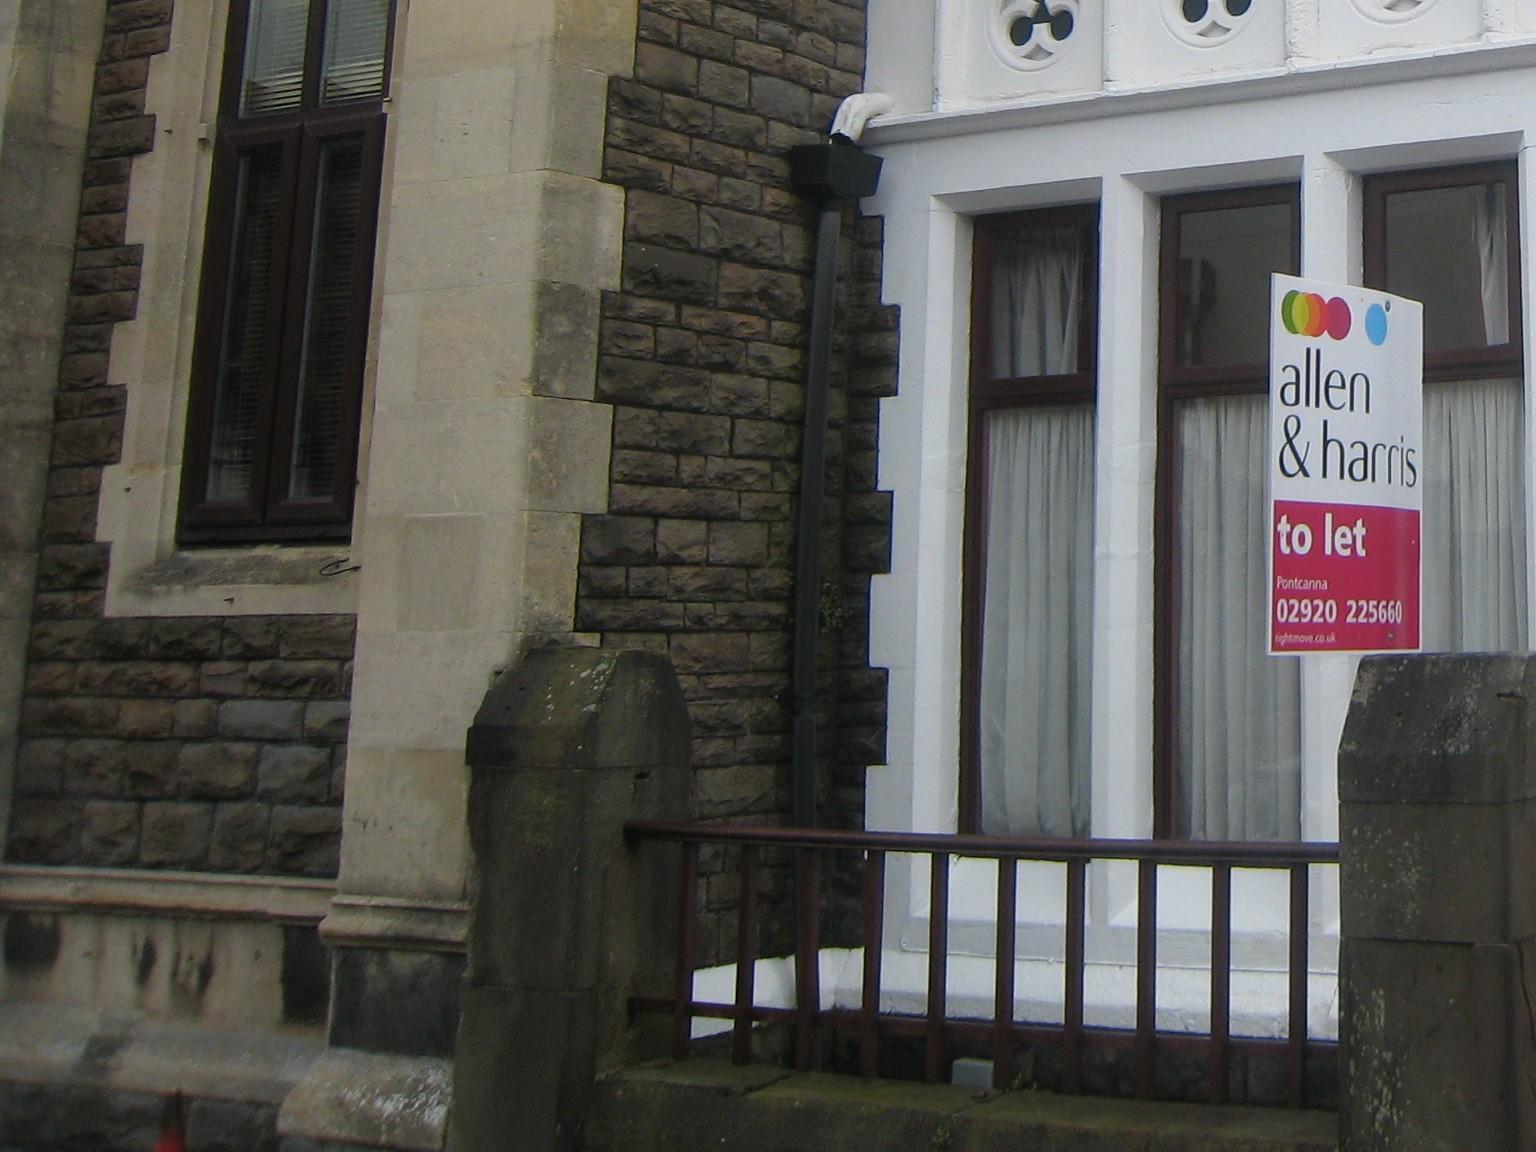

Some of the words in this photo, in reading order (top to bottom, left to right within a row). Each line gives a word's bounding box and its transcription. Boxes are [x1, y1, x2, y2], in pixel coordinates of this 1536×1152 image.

[1279, 347, 1370, 414] allen
[1278, 414, 1310, 478] &
[1322, 419, 1417, 487] harris
[1277, 514, 1312, 555] to
[1324, 512, 1366, 557] let
[1276, 575, 1328, 591] Pontcanna
[1276, 598, 1337, 623] 02920
[1346, 599, 1402, 624] 225660
